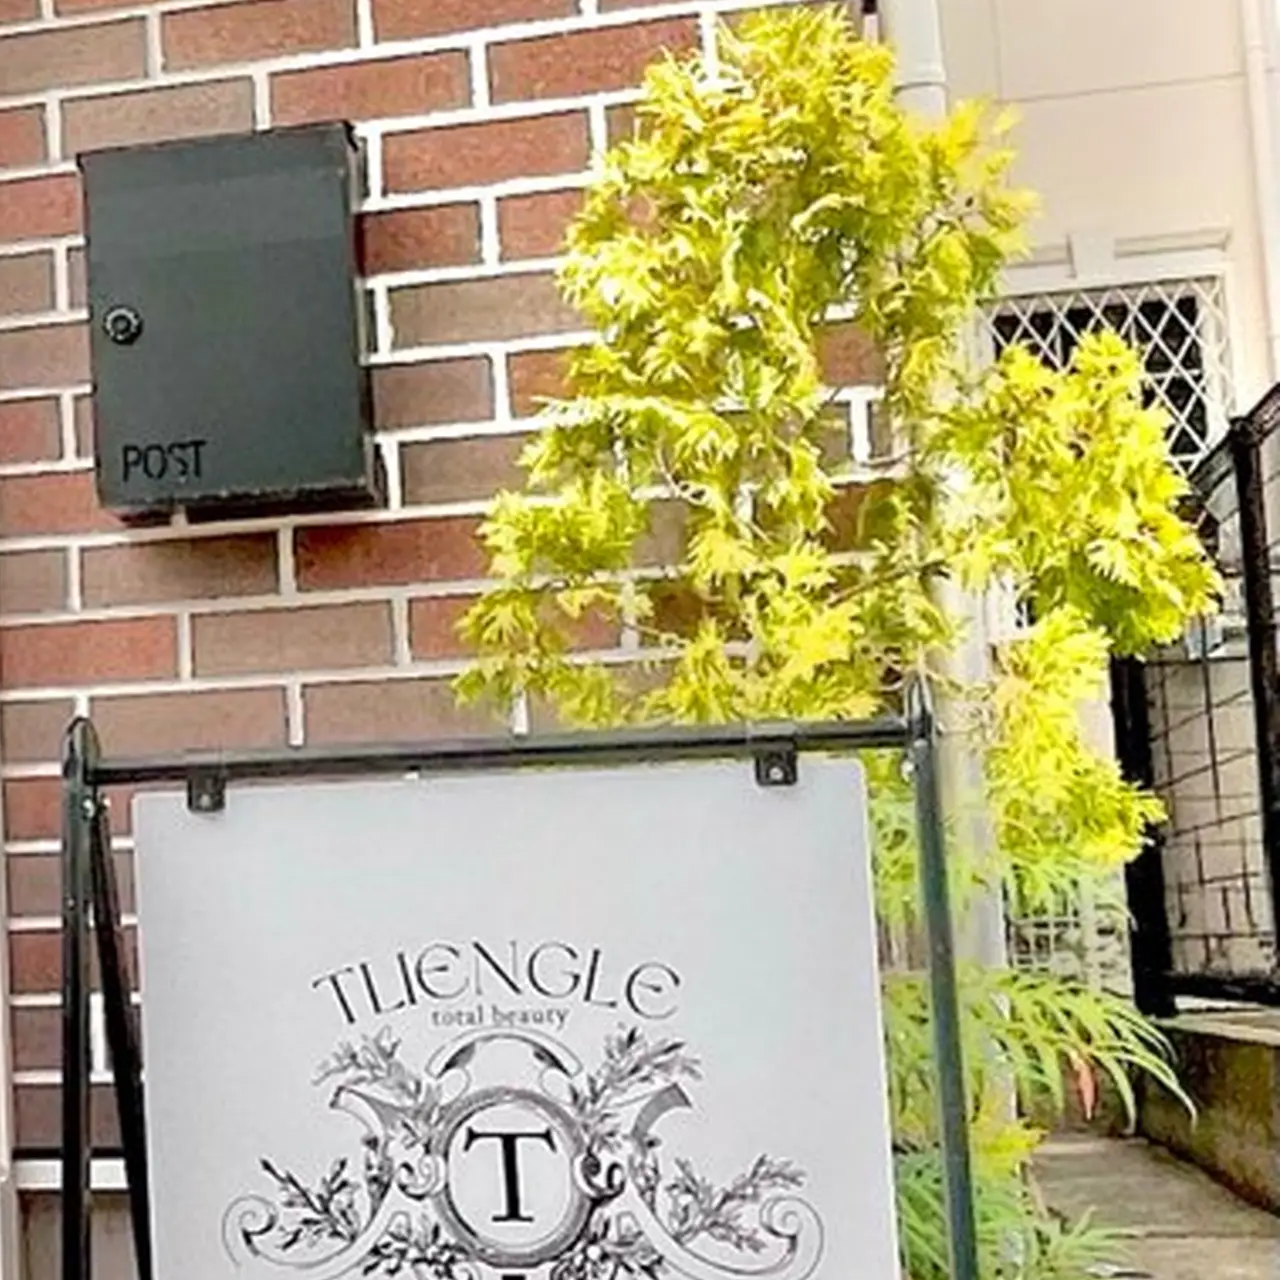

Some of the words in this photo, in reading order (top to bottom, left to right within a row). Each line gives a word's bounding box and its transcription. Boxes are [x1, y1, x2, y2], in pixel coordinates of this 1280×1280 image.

[122, 439, 207, 482] POST
[431, 1004, 484, 1026] total
[491, 1004, 570, 1031] beauty
[463, 1127, 556, 1223] T
